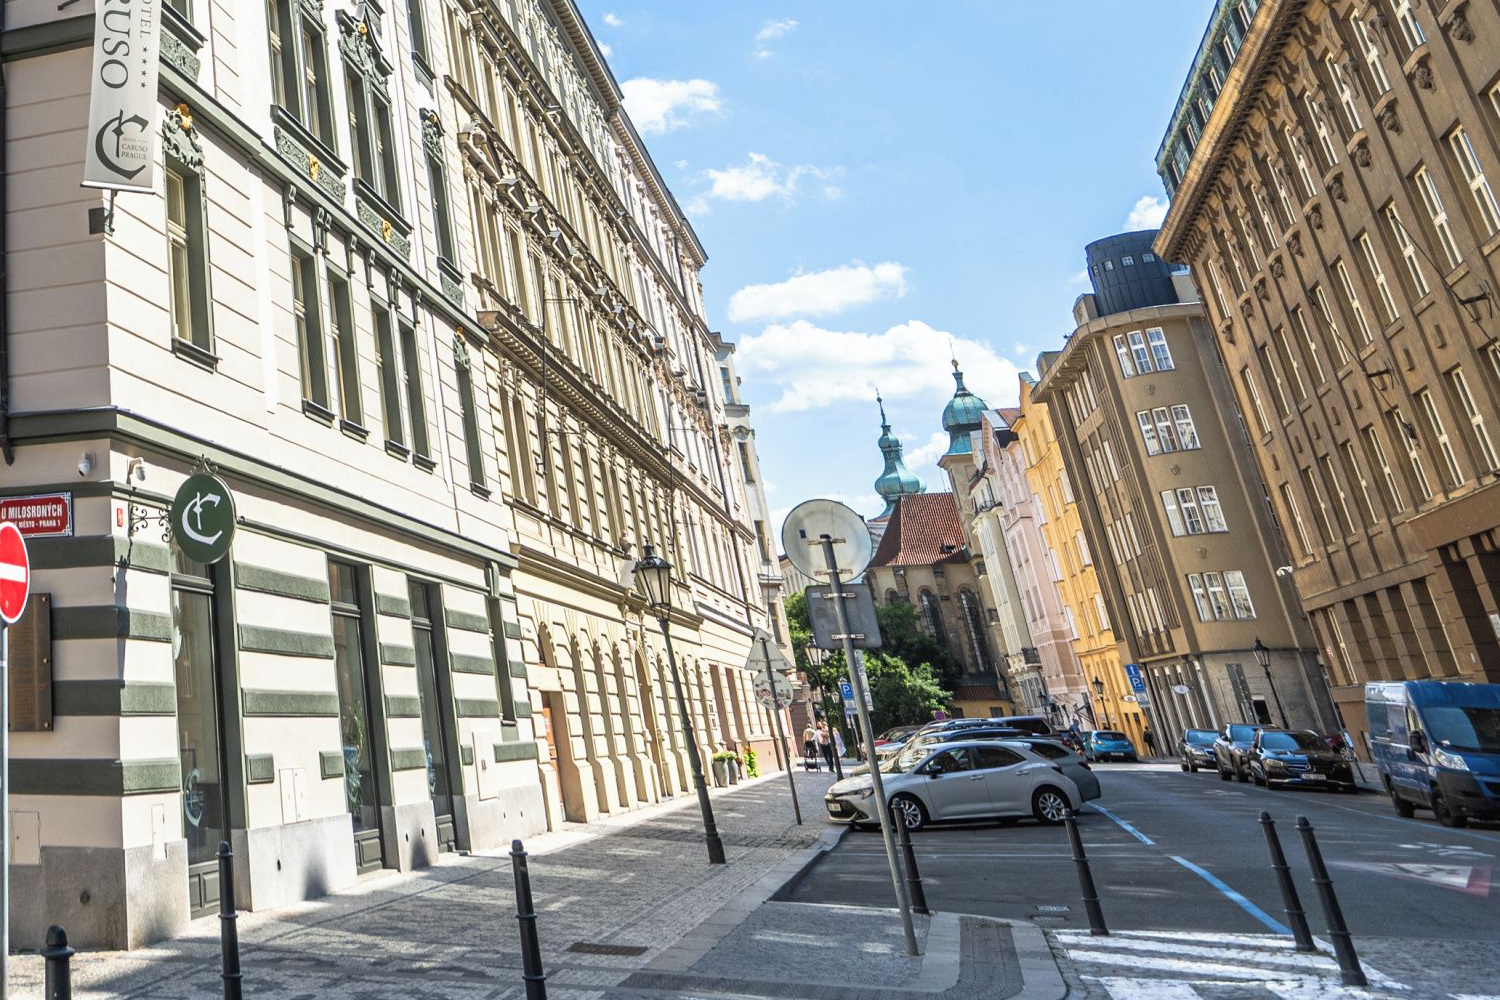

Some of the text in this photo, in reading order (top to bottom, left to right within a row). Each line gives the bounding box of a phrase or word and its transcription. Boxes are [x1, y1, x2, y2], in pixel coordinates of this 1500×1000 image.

[121, 143, 148, 153] CARUSO
[1, 502, 63, 520] U MILOSRDNÝCH
[39, 519, 57, 528] PRAHA
[1131, 677, 1140, 688] P
[842, 684, 850, 695] P
